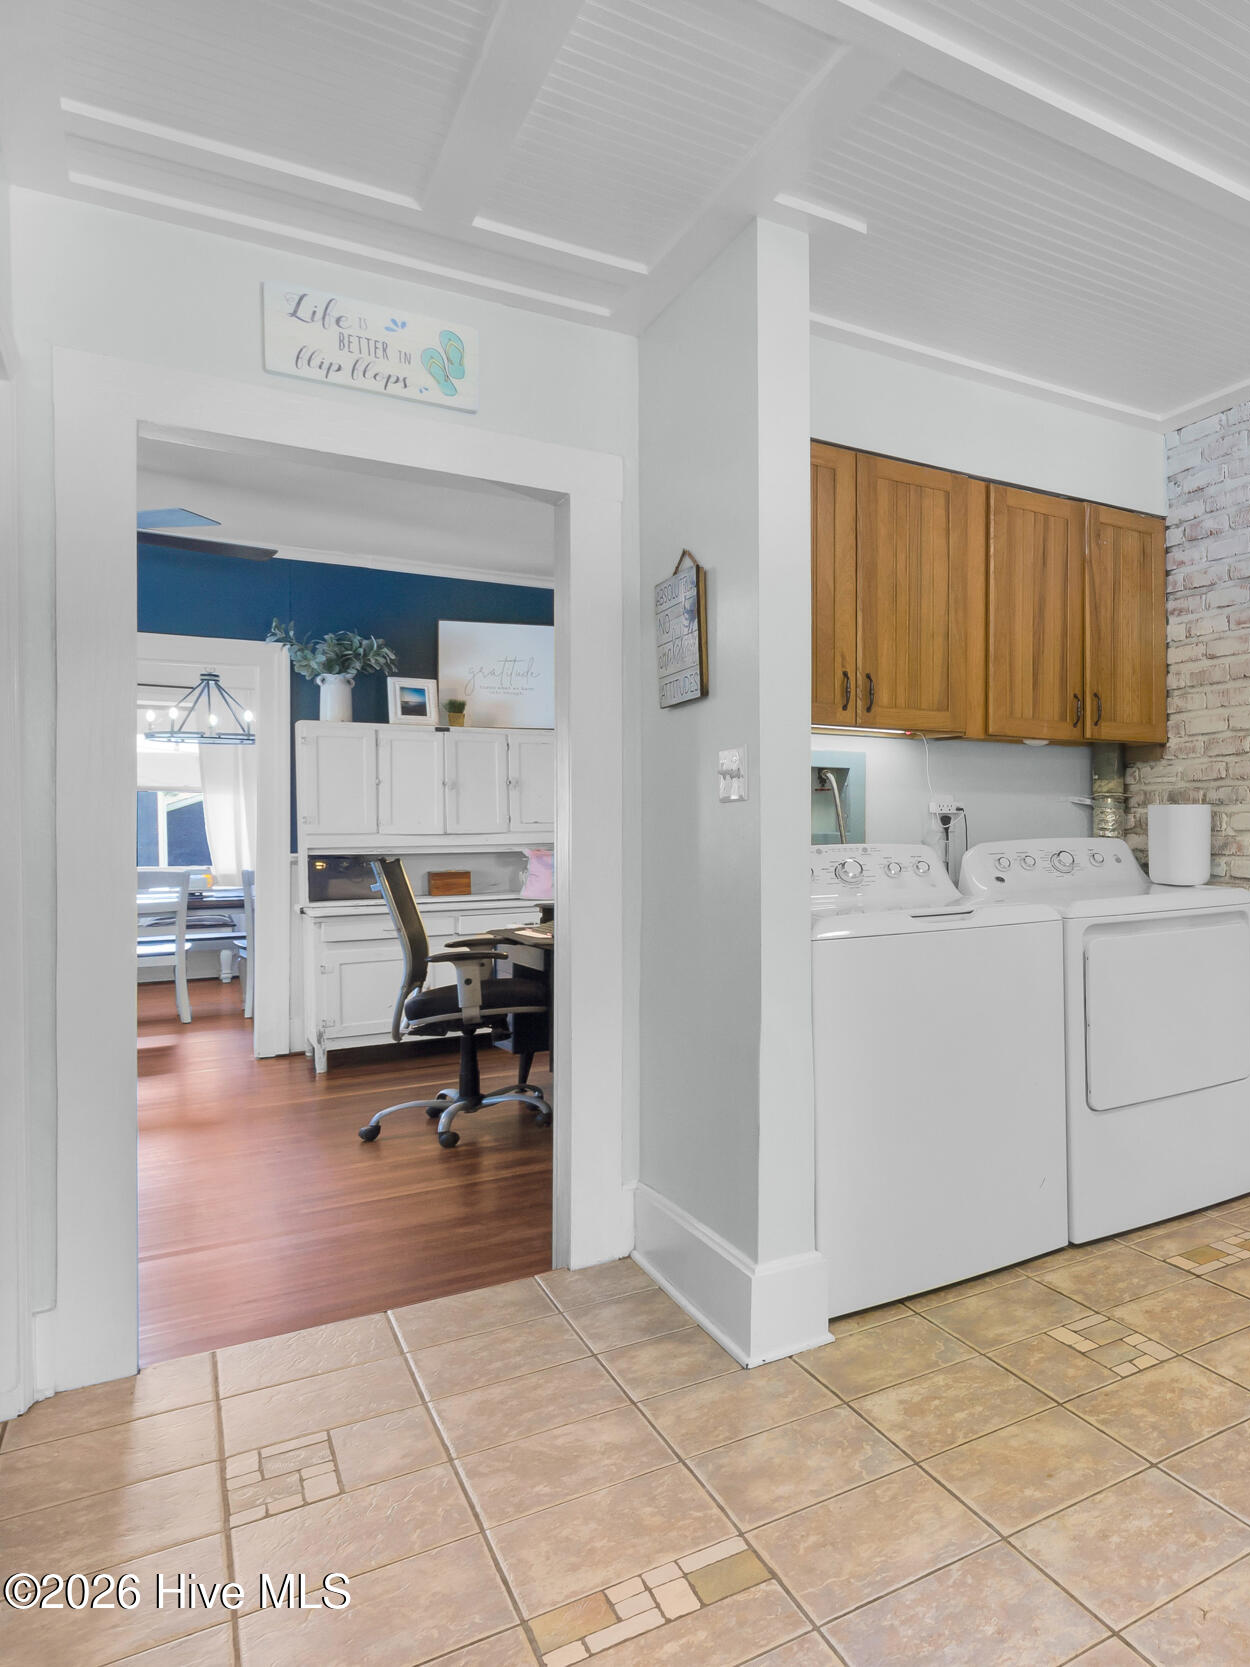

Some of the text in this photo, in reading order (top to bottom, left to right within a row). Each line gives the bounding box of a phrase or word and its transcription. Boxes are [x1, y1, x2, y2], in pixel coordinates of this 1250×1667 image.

[284, 292, 369, 330] Life IS
[338, 331, 412, 366] BETTER IN
[294, 344, 408, 391] flip flops
[658, 612, 672, 636] NO
[464, 655, 542, 697] gratitude
[661, 671, 700, 700] ATTITUDES
